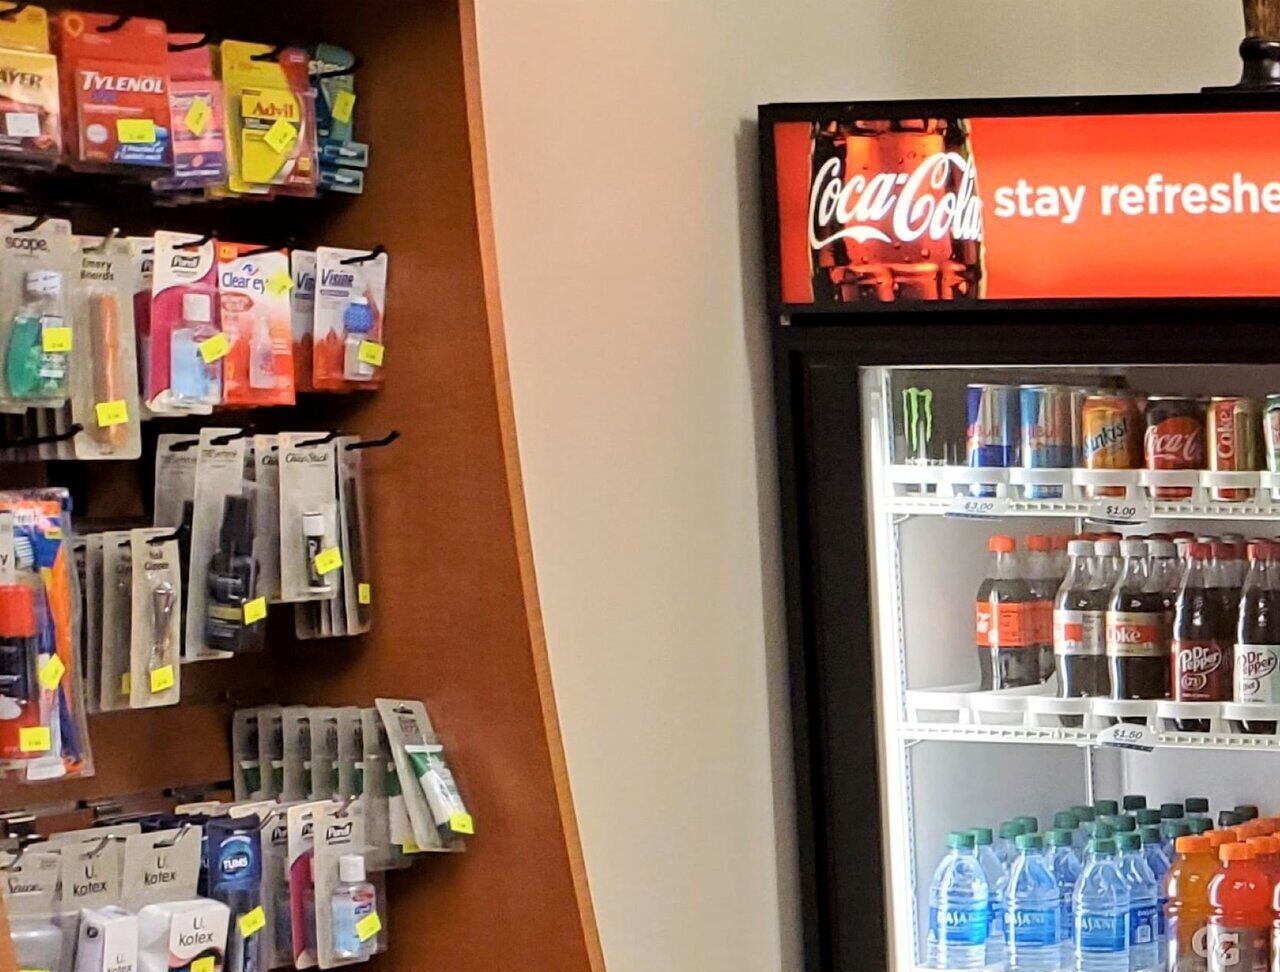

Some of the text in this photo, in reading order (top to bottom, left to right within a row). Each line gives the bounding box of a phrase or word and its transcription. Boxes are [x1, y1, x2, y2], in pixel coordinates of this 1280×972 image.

[0, 68, 43, 89] AYER
[80, 71, 165, 94] TYLENOL
[252, 103, 294, 119] Advil
[809, 151, 983, 249] Coca-Cola
[994, 178, 1086, 223] stay
[5, 237, 48, 252] scope
[82, 259, 111, 271] Emery
[222, 273, 254, 290] Clear
[321, 269, 354, 288] Visine
[1217, 407, 1234, 459] Coke
[1106, 505, 1137, 517] $1.00
[1113, 728, 1143, 740] $1.50
[223, 857, 249, 871] TUMS
[144, 871, 177, 885] kotex
[73, 882, 107, 896] kotex
[179, 932, 214, 946] kotex
